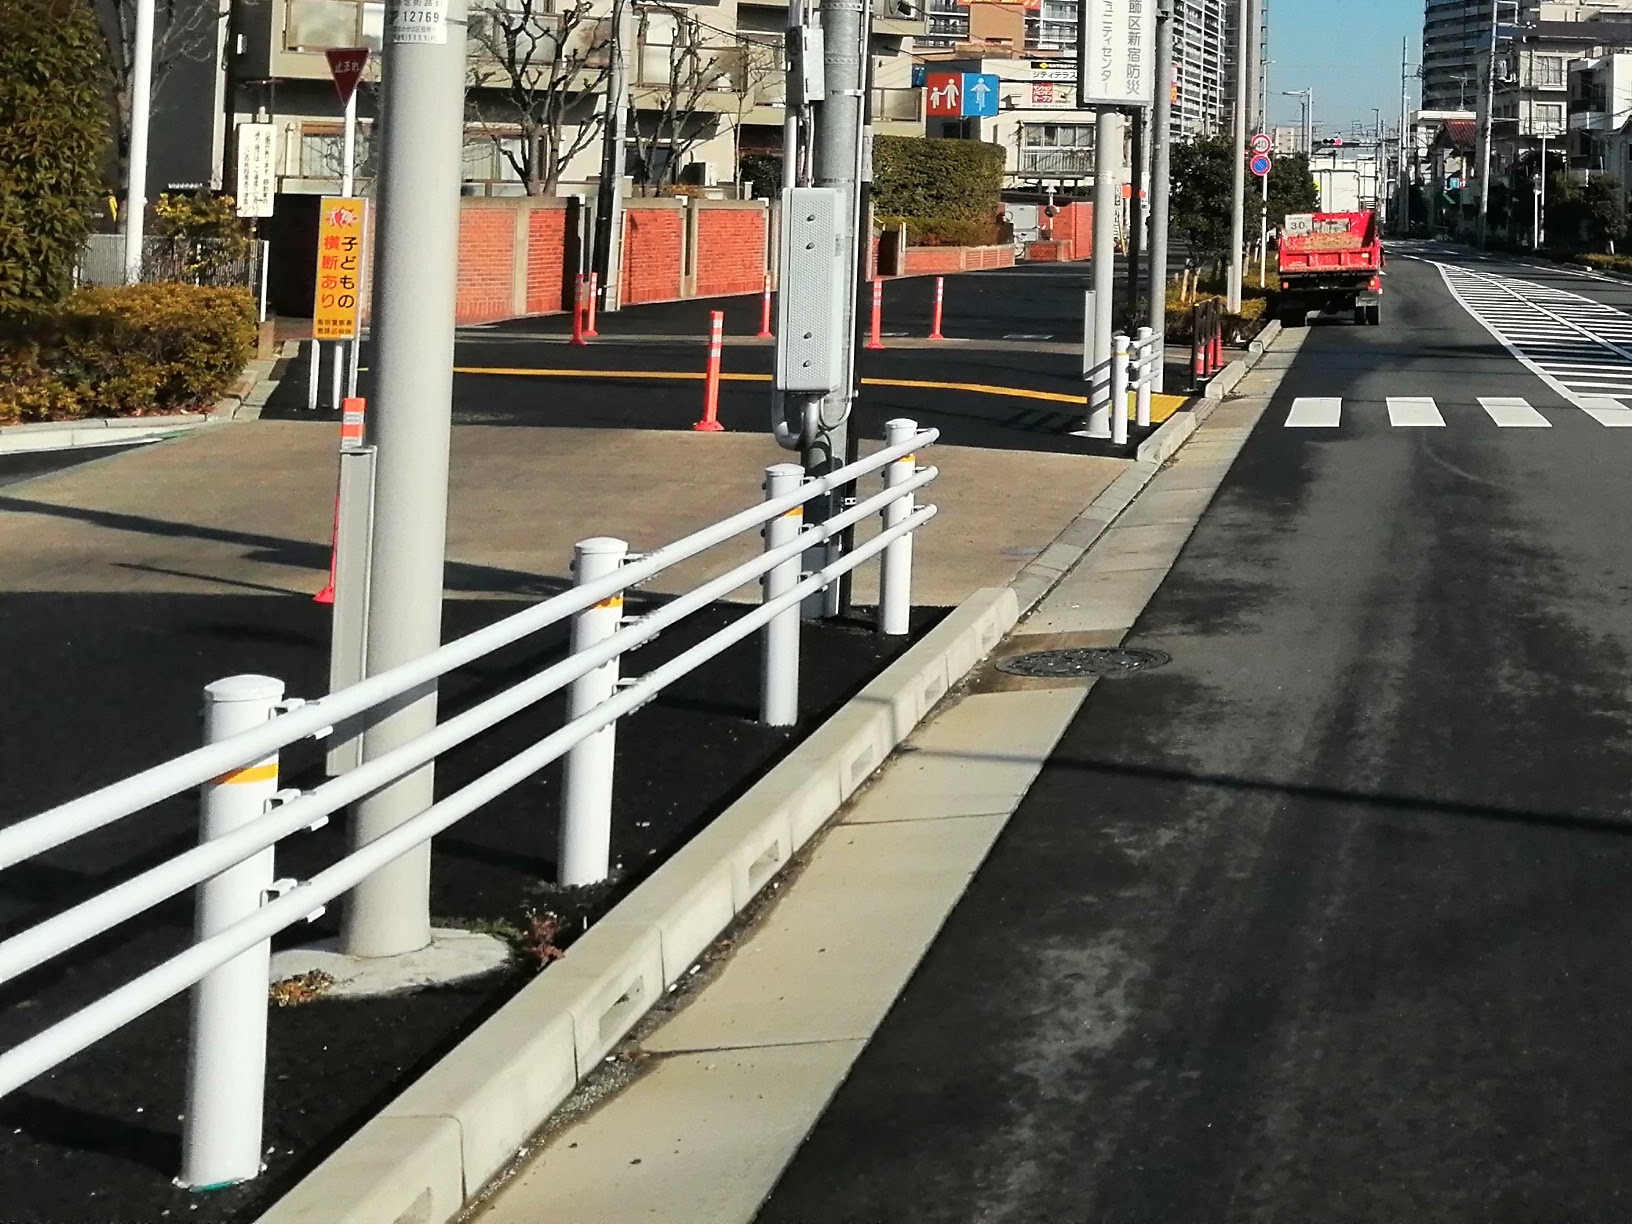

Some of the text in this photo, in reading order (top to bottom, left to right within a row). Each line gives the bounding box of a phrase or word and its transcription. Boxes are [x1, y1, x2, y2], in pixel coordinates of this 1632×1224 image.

[403, 10, 440, 23] 12769
[321, 235, 340, 309] 横断あり
[338, 236, 358, 309] 子どもの
